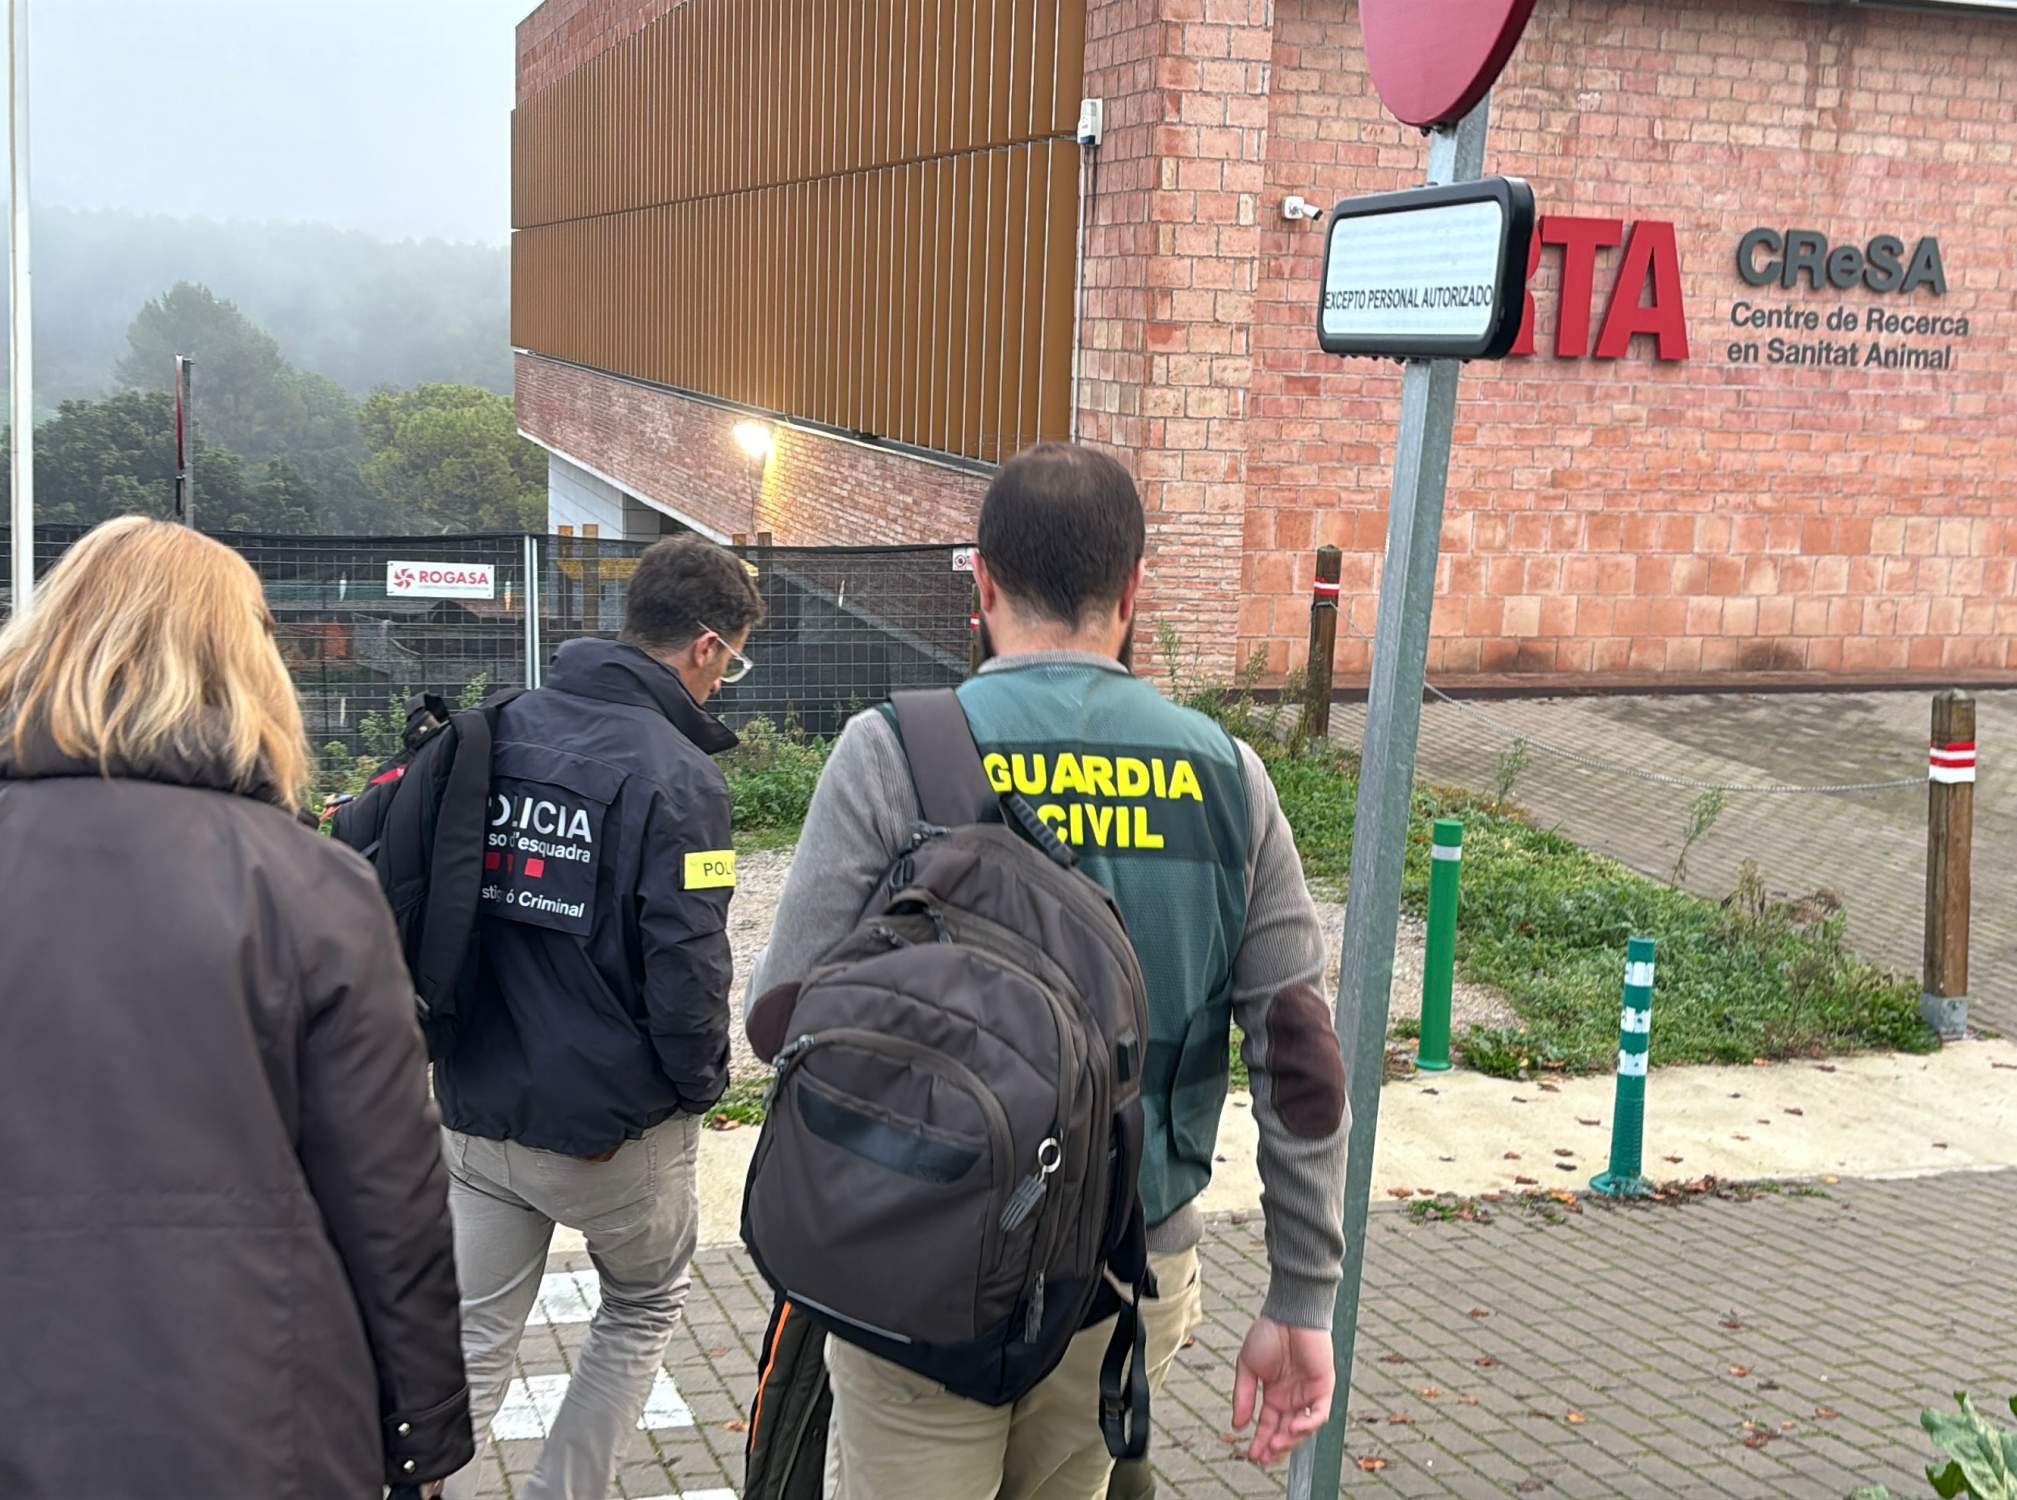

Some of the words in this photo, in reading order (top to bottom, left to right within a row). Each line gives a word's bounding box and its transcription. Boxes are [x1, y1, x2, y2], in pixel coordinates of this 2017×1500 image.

[1737, 227, 1947, 295] CReSA
[1324, 290, 1366, 310] EXCEPTO
[1367, 287, 1419, 309] PERSONAL
[1421, 284, 1494, 308] AUTORIZADO
[1511, 215, 1689, 361] TA
[1730, 301, 1819, 330] Centre
[1826, 306, 1858, 332] de
[1866, 307, 1969, 336] Recerca
[1727, 342, 1759, 363] en
[1766, 337, 1859, 368] Sanitat
[1863, 341, 1952, 370] Animal
[418, 570, 489, 585] ROGASA
[983, 752, 1204, 803] GUARDIA
[1036, 803, 1165, 848] CIVIL
[518, 891, 585, 918] Criminal
